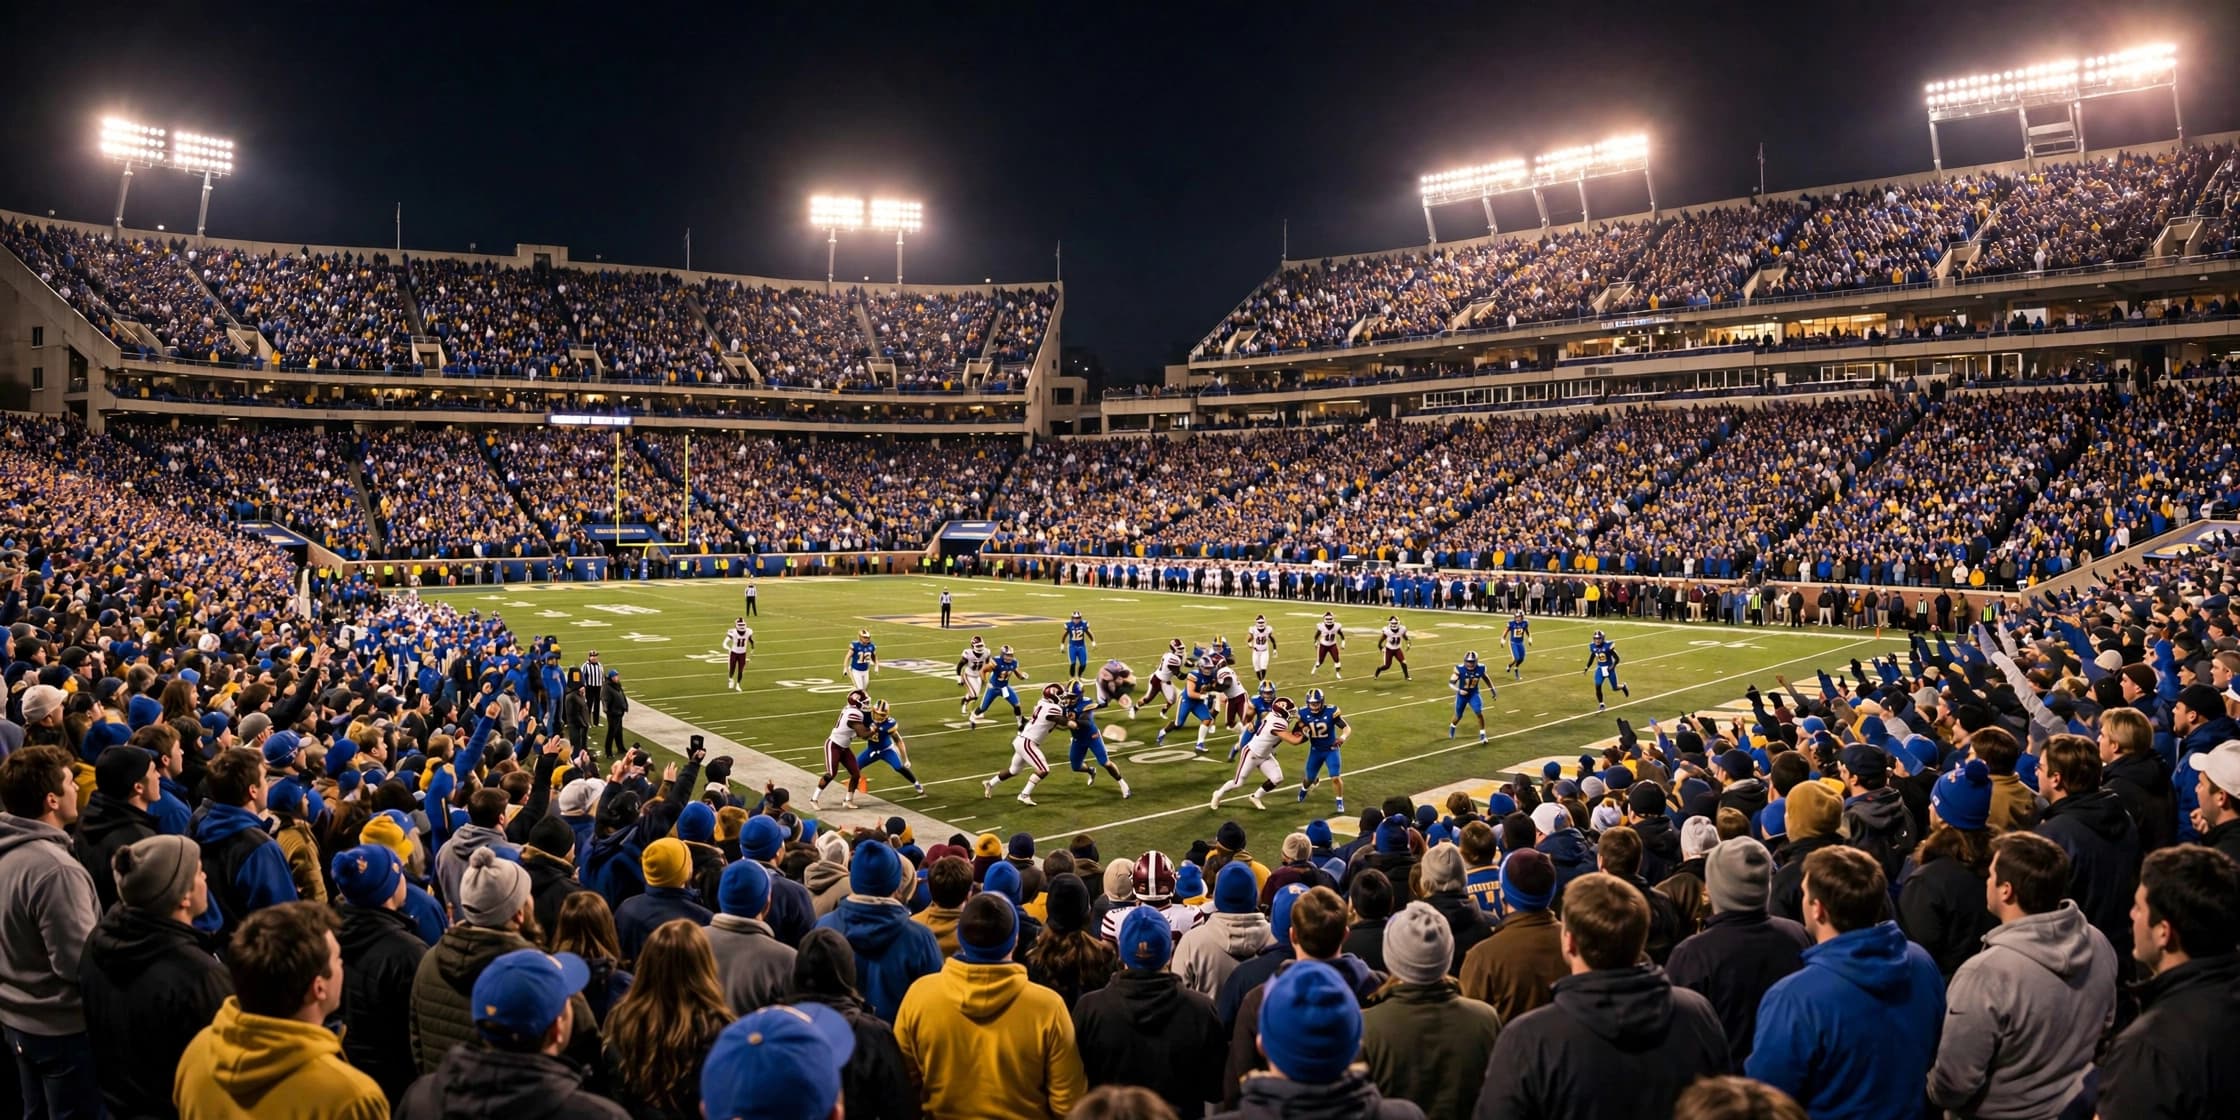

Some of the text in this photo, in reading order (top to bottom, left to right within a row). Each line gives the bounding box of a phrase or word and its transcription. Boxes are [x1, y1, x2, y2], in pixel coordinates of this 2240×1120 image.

[1072, 630, 1084, 641] 12
[737, 638, 746, 647] 11
[857, 652, 872, 664] 12
[1309, 721, 1330, 738] 12
